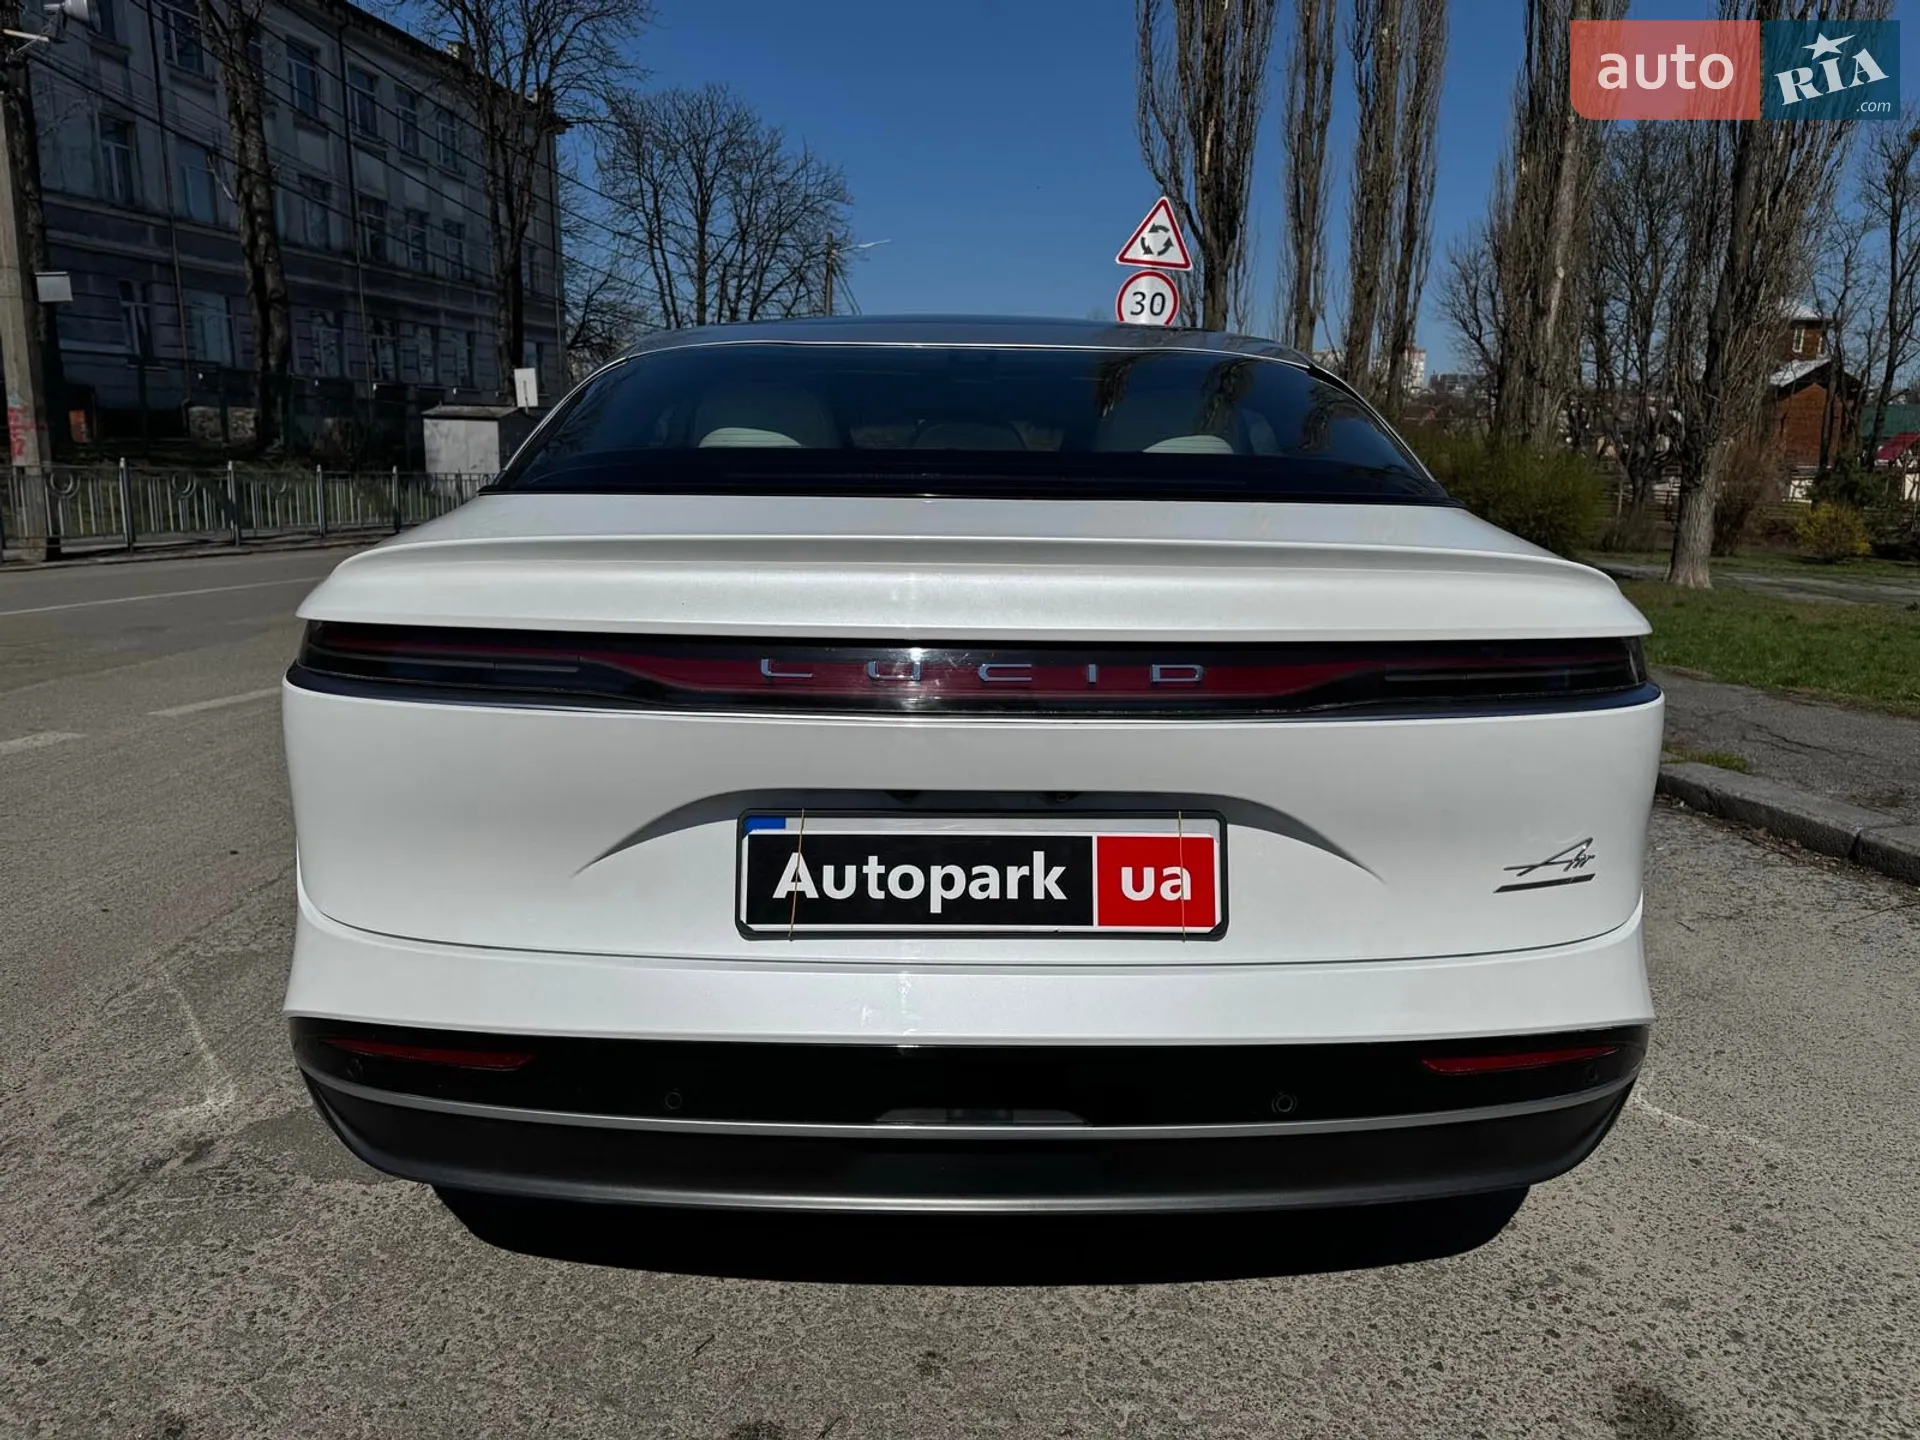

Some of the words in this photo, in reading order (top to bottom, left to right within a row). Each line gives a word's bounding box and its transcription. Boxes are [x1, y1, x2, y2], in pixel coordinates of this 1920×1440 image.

[1130, 291, 1166, 316] 30
[761, 658, 1205, 683] LUCID
[772, 851, 1067, 914] Autopark
[1120, 865, 1192, 901] ua
